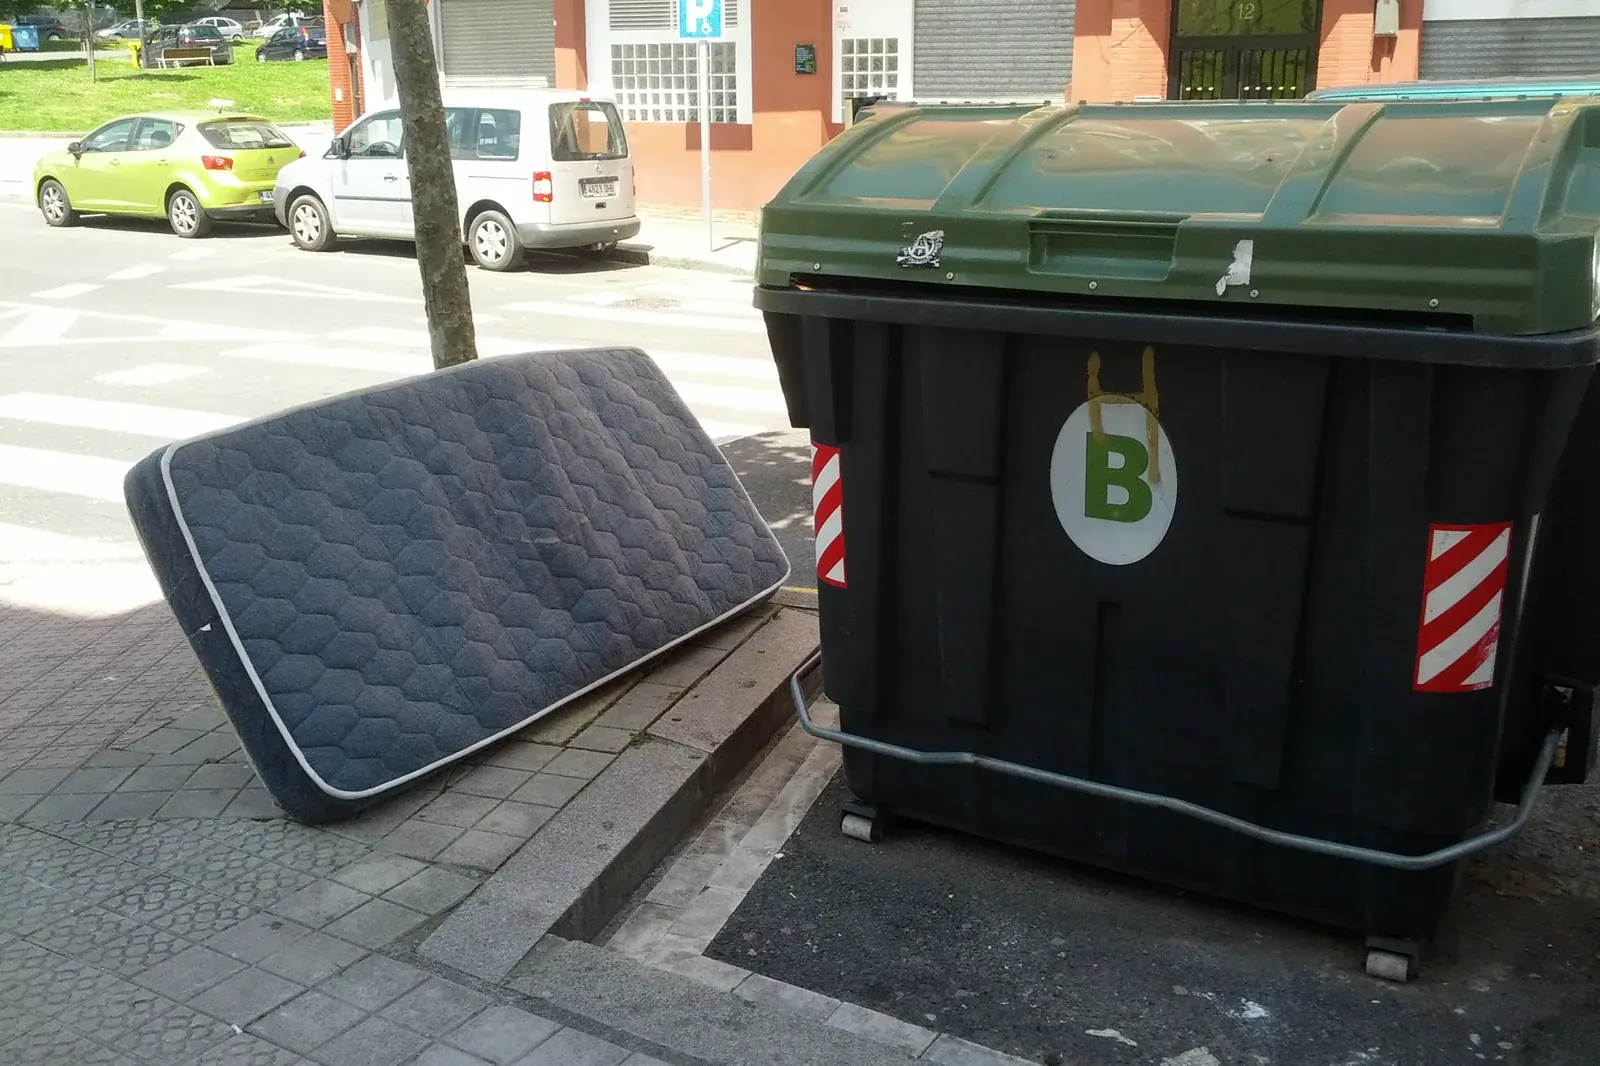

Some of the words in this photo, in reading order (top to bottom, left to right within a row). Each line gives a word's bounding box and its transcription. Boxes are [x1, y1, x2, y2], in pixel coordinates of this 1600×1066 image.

[686, 0, 713, 32] P
[1237, 3, 1255, 19] 12
[1084, 431, 1153, 523] B
